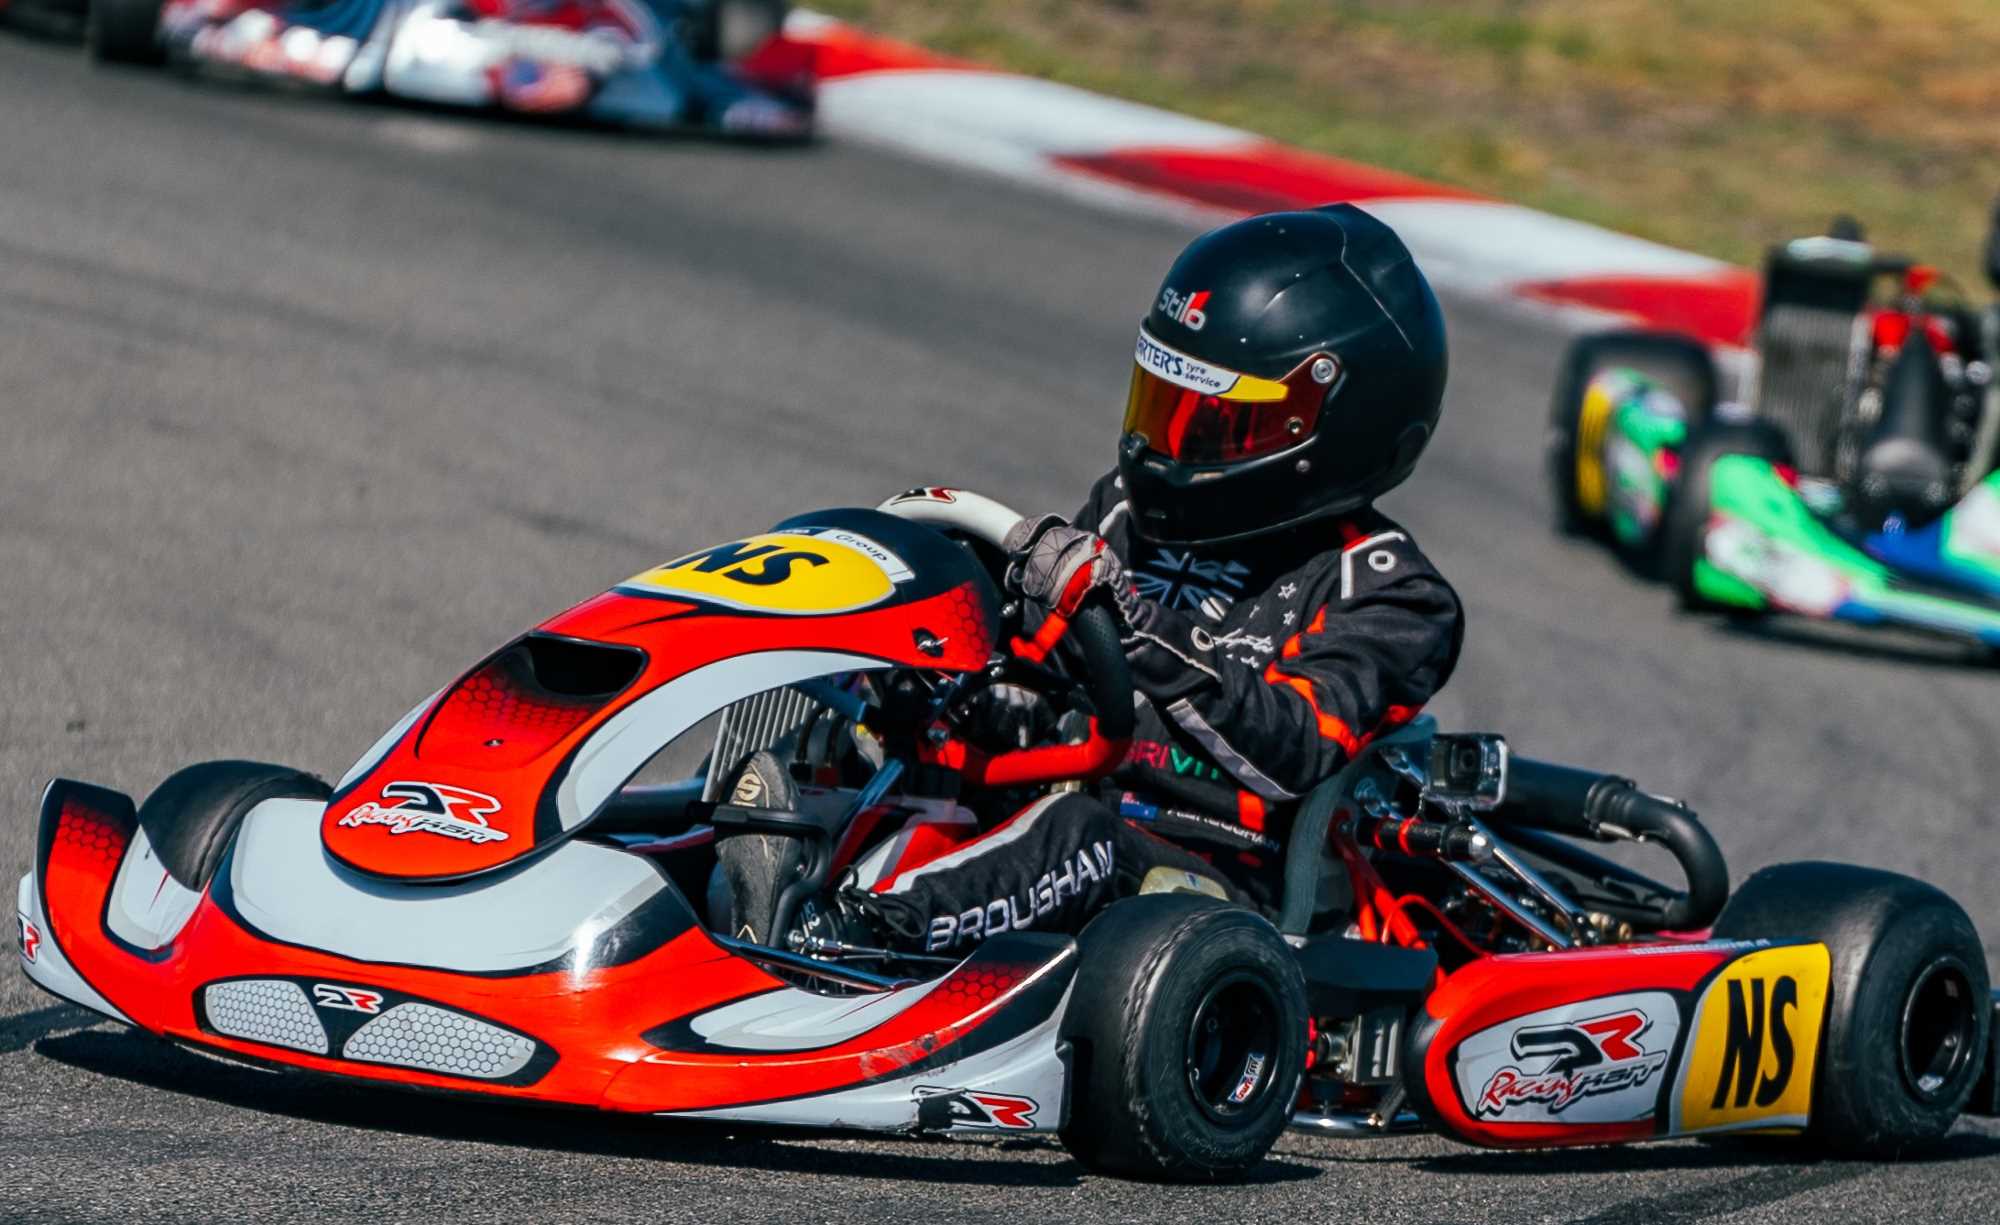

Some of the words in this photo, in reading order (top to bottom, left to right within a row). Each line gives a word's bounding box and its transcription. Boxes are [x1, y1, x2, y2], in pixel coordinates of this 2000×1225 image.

[1184, 373, 1221, 388] service
[661, 542, 829, 585] NS
[836, 534, 887, 561] Group
[1711, 976, 1798, 1109] NS
